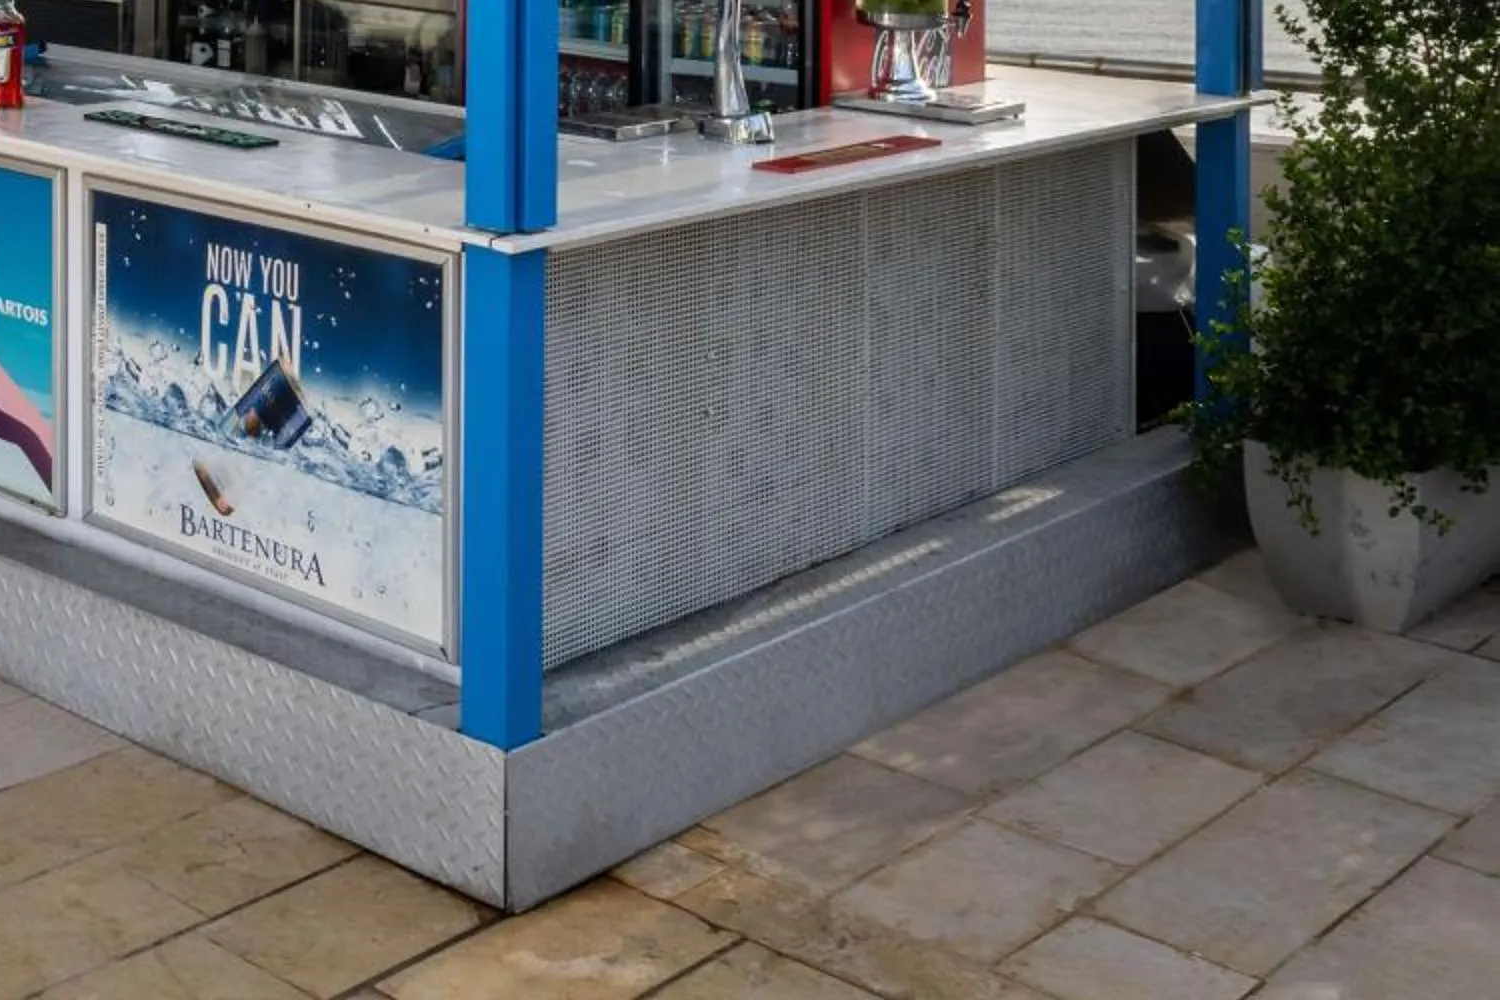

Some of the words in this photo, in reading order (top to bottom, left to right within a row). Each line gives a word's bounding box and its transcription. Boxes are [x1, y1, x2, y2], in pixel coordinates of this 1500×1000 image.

[206, 242, 252, 289] NOW
[259, 255, 299, 301] YOU
[201, 283, 302, 396] CAN
[179, 503, 325, 587] BARTENURA
